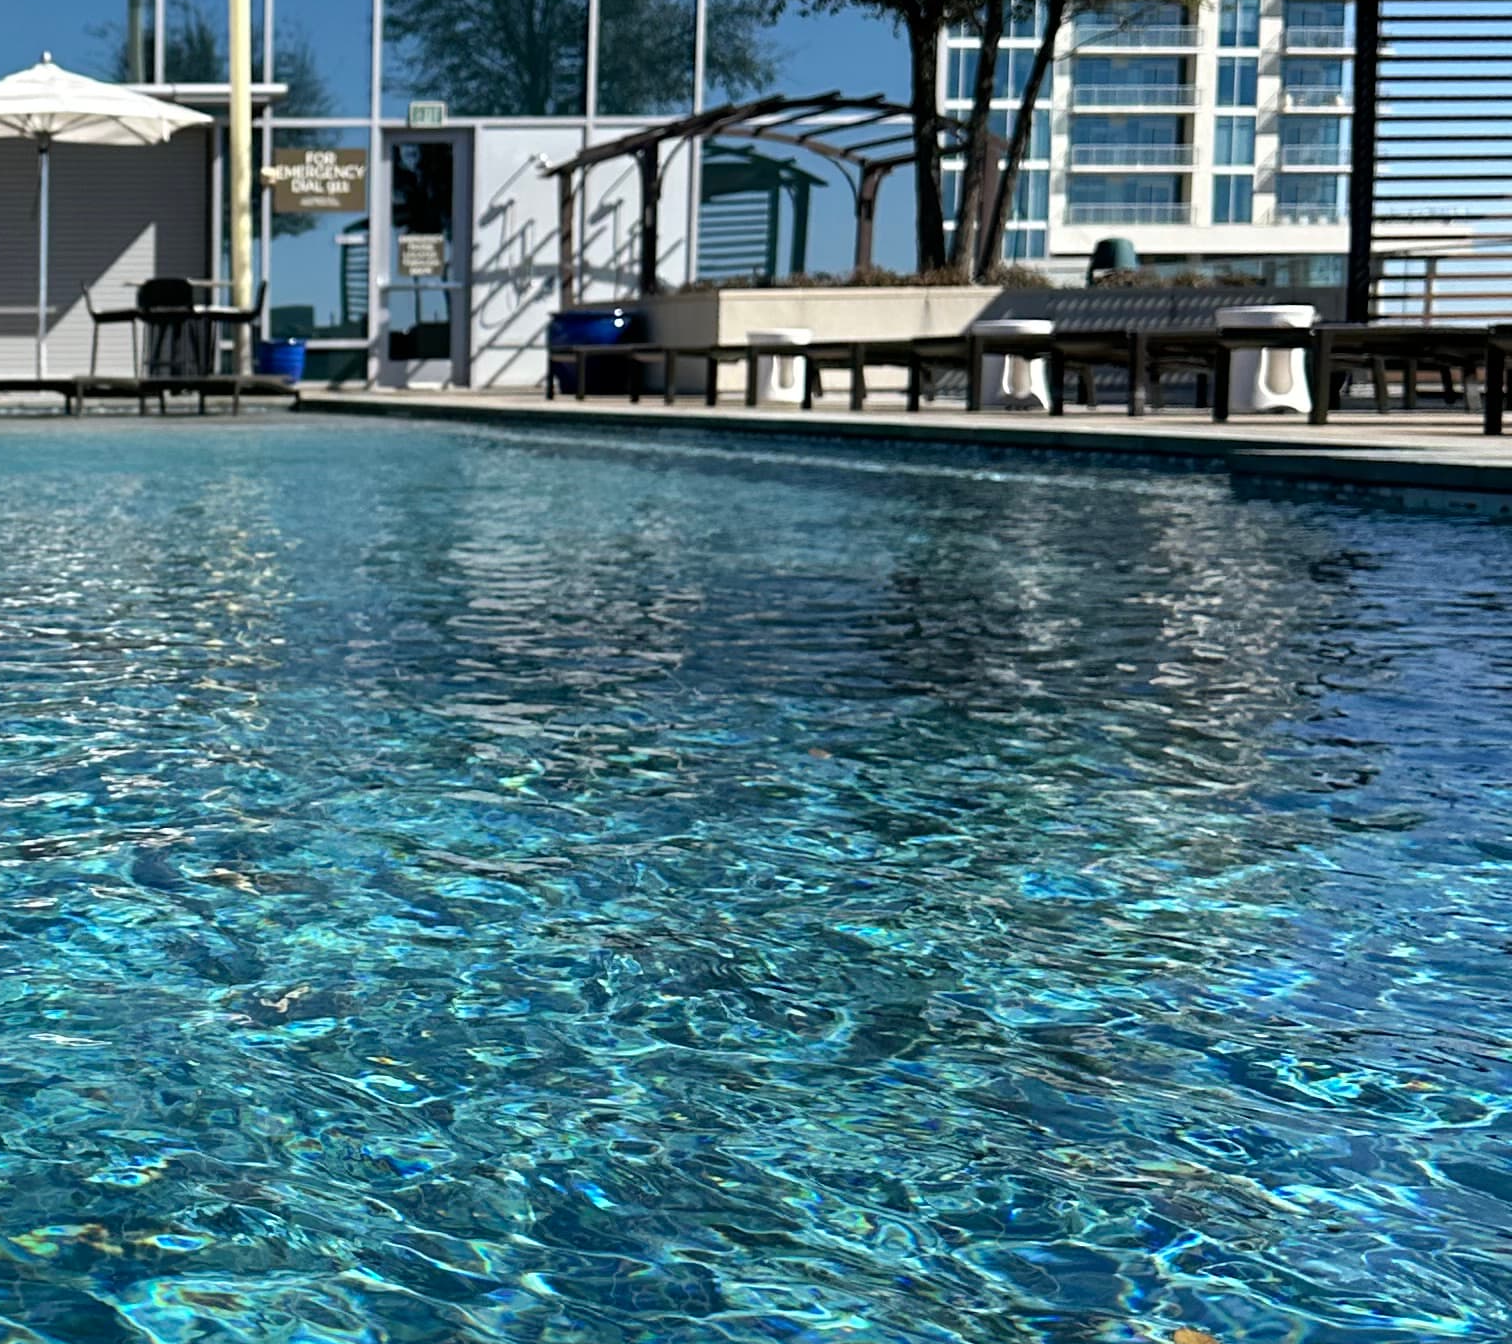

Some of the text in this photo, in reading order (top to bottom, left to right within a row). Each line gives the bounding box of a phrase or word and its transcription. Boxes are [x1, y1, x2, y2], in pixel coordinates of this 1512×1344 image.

[305, 150, 337, 165] FOR
[275, 164, 365, 180] EMERGENCY
[291, 178, 350, 194] DIAL 911
